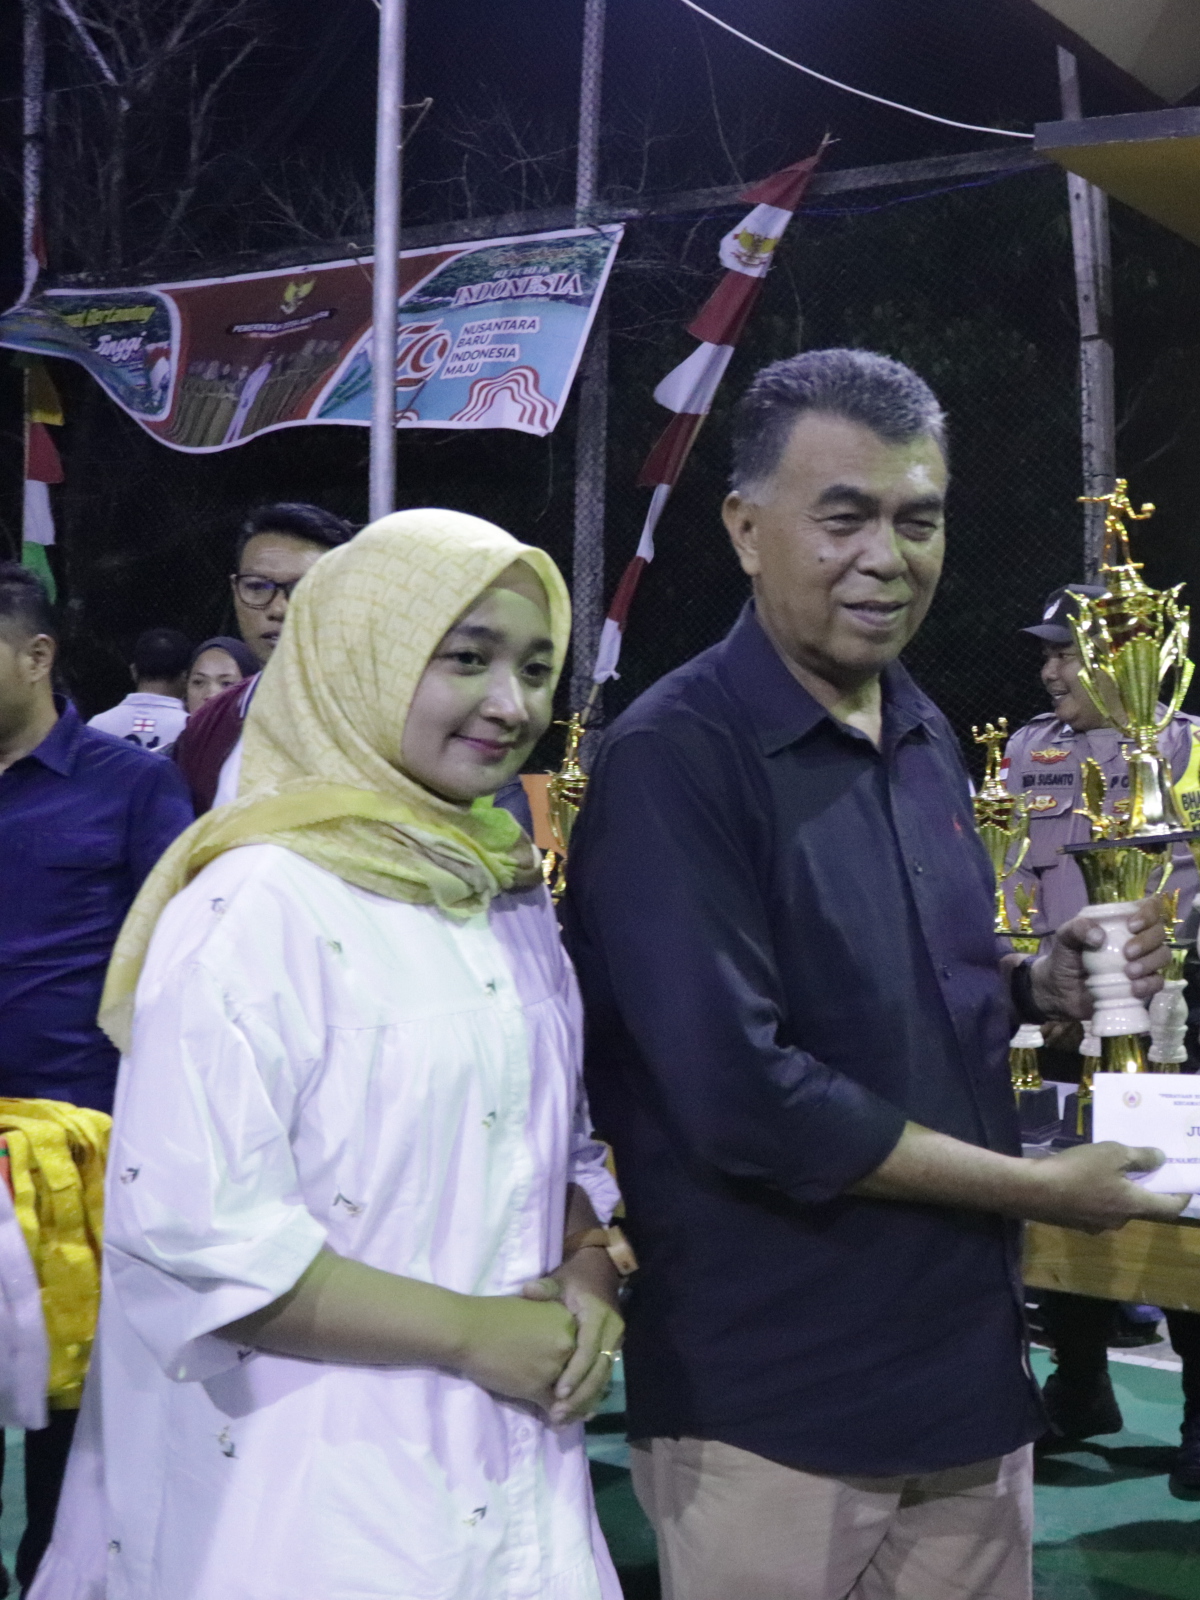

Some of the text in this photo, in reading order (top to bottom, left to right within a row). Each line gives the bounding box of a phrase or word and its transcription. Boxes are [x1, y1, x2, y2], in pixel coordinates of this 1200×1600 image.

[454, 273, 583, 306] INDONESIA
[463, 319, 537, 335] NUSANTARA
[457, 335, 490, 348] BARU
[450, 349, 516, 362] INDONESIA
[445, 362, 478, 375] MAJU
[1038, 773, 1074, 786] SUSANTO
